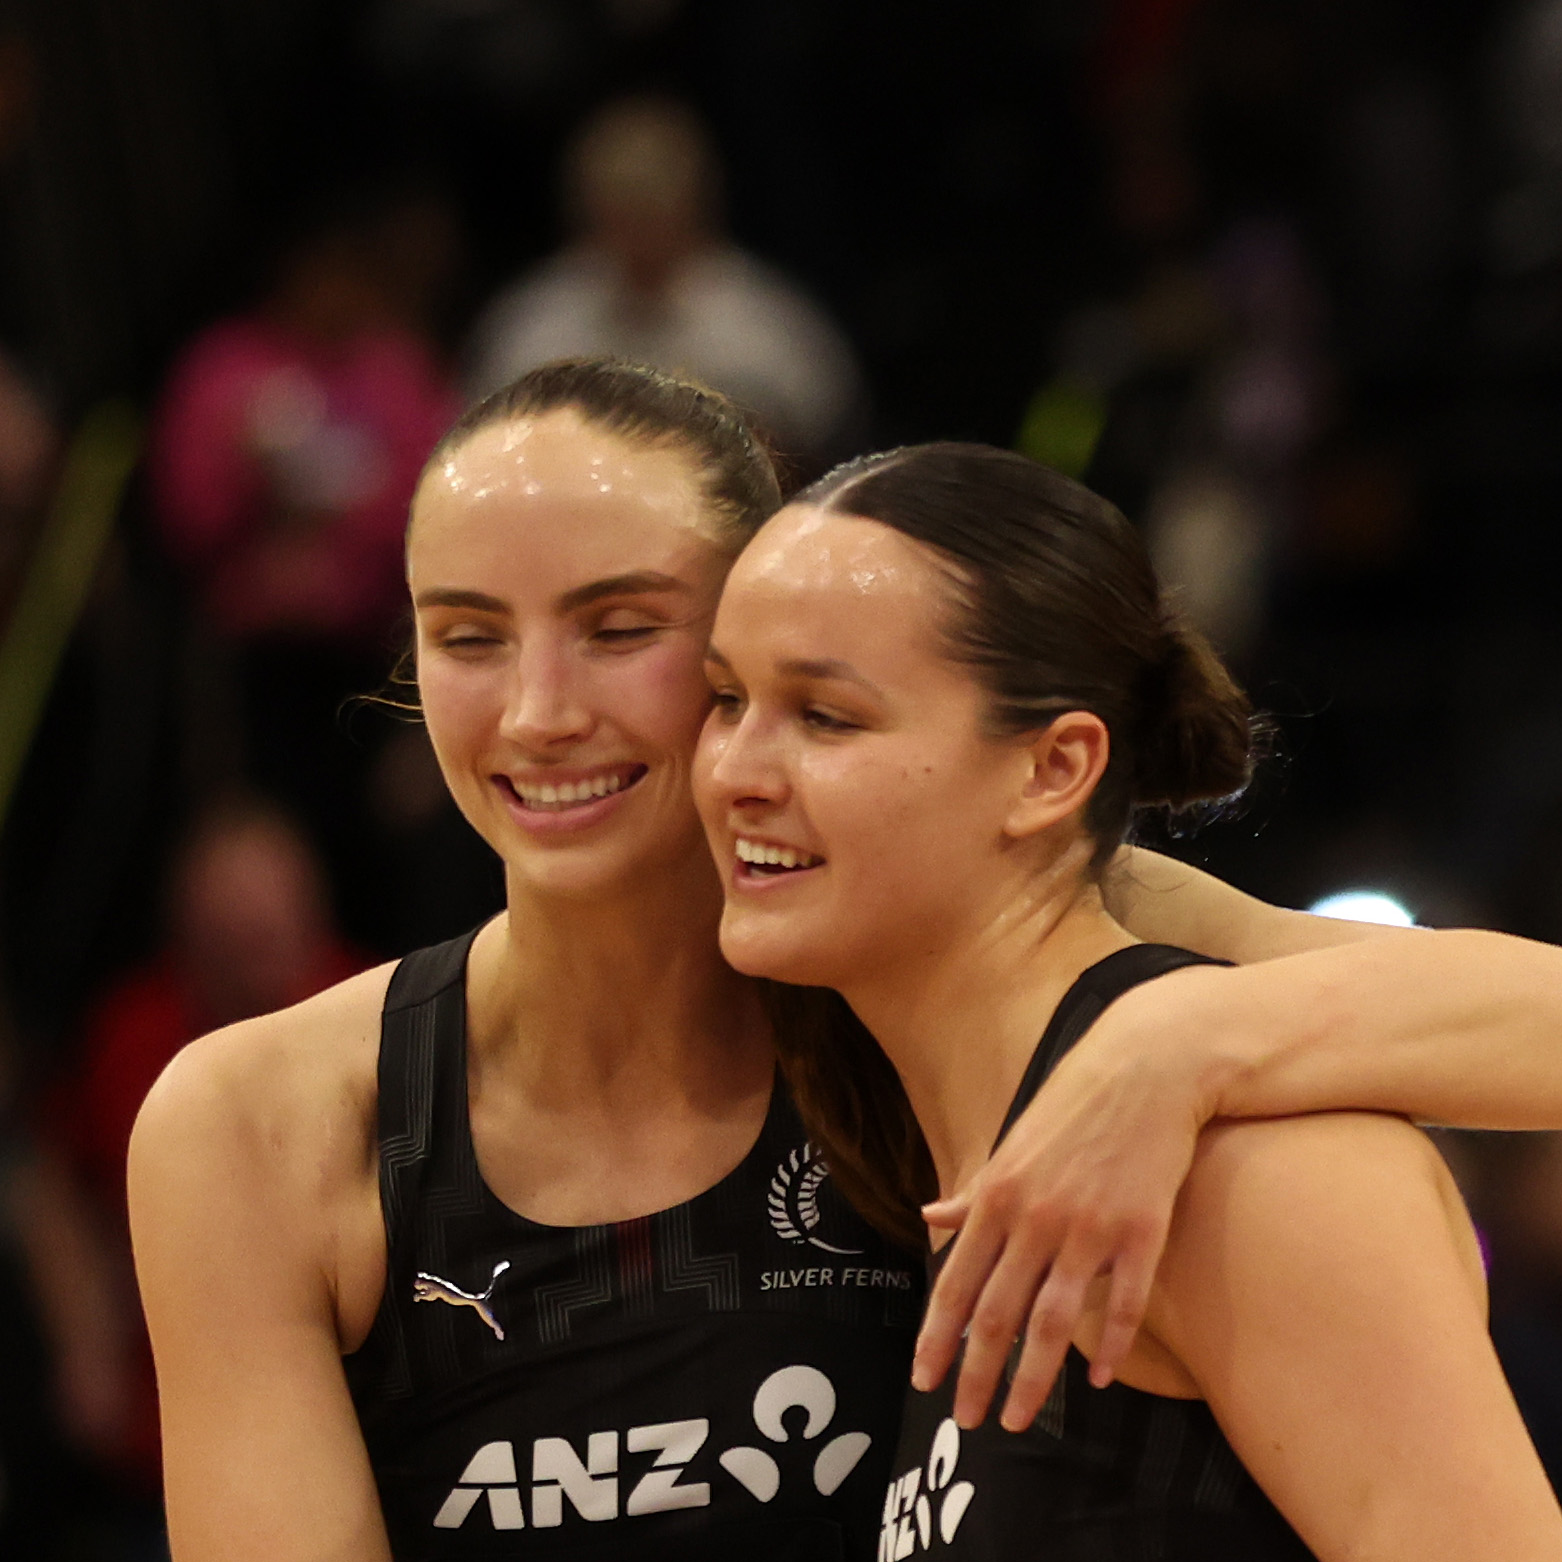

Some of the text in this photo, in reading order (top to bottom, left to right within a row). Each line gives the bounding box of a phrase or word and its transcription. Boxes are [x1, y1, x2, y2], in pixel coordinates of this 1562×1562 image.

[760, 1267, 911, 1291] SILVER FERNS
[433, 1418, 711, 1530] ANZ
